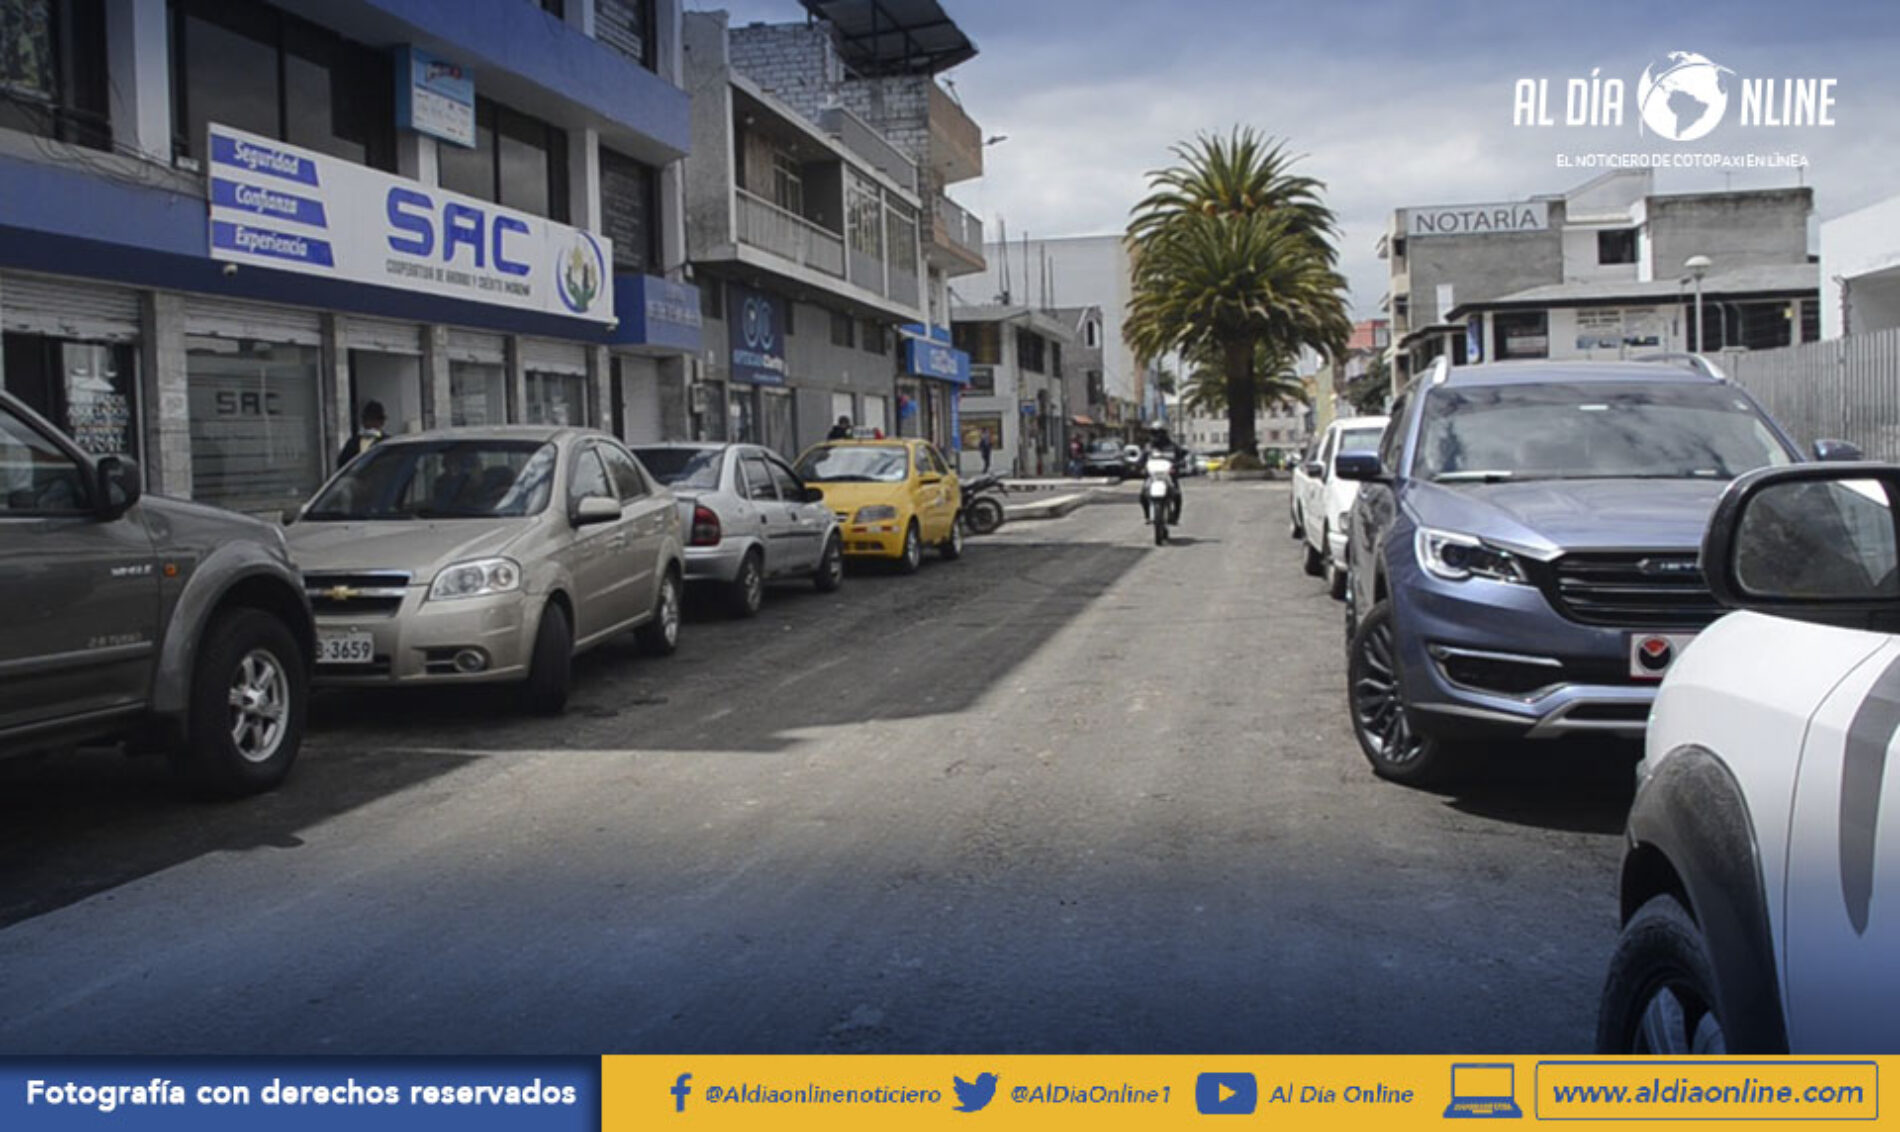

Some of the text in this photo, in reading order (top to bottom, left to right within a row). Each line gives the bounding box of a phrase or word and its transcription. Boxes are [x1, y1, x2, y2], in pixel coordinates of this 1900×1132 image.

[233, 140, 300, 175] Seguridad
[234, 185, 299, 215] Confianza
[386, 186, 532, 277] SAC
[1415, 205, 1540, 233] NOTARÍA
[234, 226, 309, 257] Experiencia
[216, 391, 282, 416] SAC
